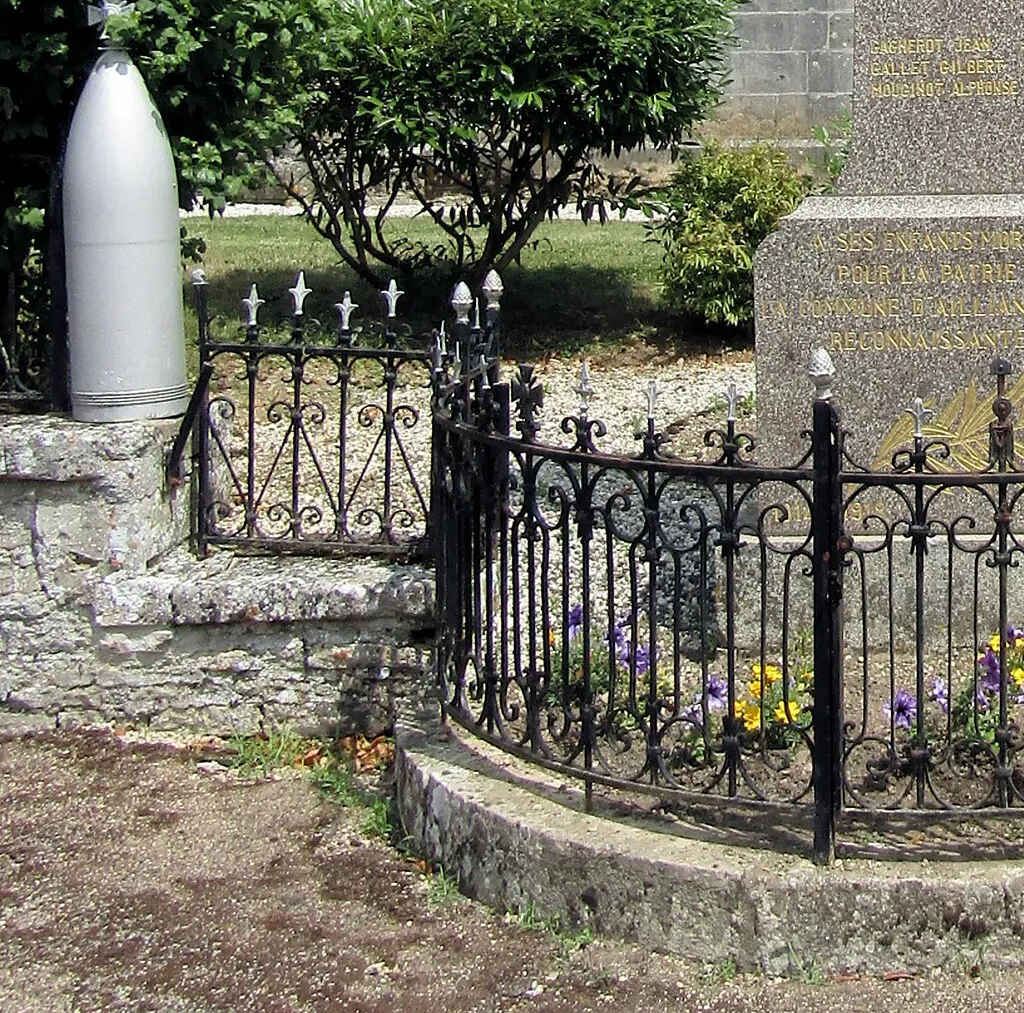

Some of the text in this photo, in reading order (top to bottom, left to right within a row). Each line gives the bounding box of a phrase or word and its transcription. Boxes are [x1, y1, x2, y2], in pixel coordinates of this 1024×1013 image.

[954, 37, 992, 53] JEAN
[939, 59, 1004, 75] GILBERT
[952, 80, 1019, 97] ALPHONSE
[814, 232, 826, 252] A
[836, 232, 875, 252] SES
[883, 231, 973, 251] ENFANTS
[837, 262, 1017, 285] POUR LA PATRIE
[760, 296, 789, 319] LA
[799, 297, 900, 318] COMMUNE
